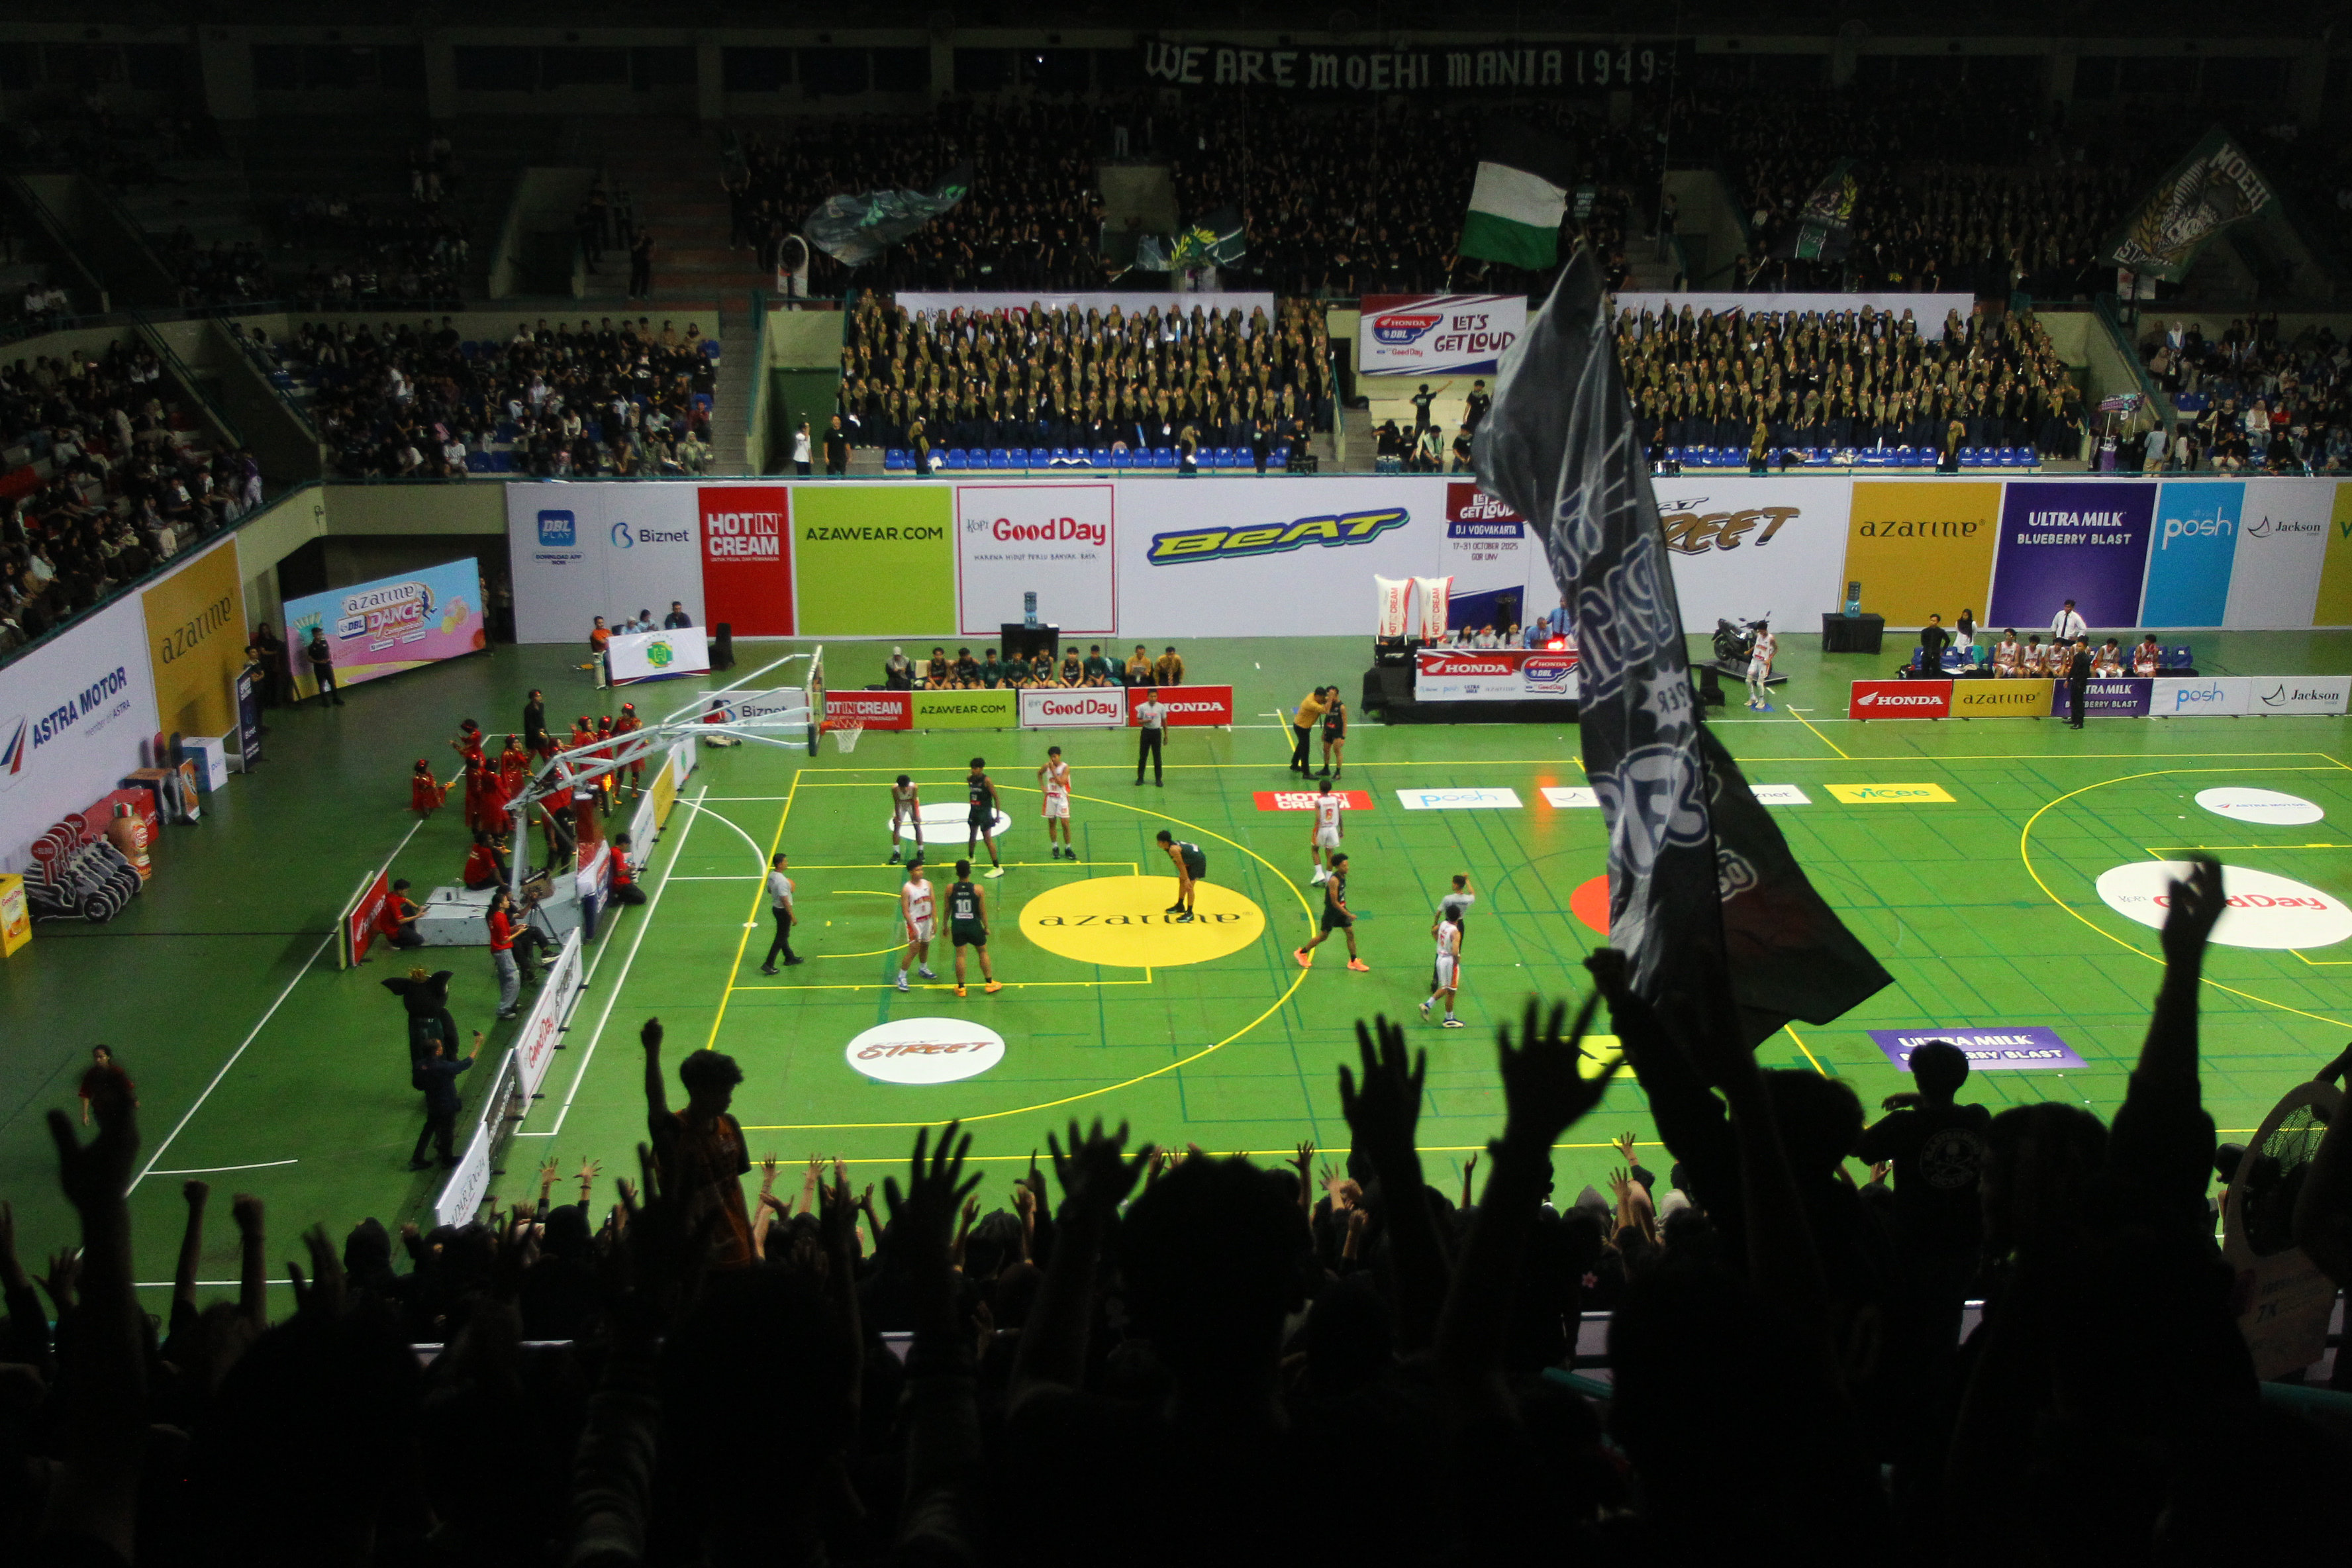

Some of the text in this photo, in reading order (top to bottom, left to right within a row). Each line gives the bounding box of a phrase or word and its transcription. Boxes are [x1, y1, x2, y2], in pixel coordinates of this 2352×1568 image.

[1144, 40, 1655, 91] WE ARE MOEHI MANIA 1949
[1452, 314, 1489, 331] LET'S
[1390, 330, 1408, 339] DBL
[1434, 332, 1516, 354] GET LOUD
[1460, 506, 1483, 518] GET
[2028, 511, 2124, 526] ULTRA MILK
[543, 520, 571, 532] DBL
[708, 513, 779, 535] HOT IN
[993, 517, 1055, 541] Good
[1059, 516, 1106, 546] Day
[1468, 524, 1516, 535] YOGYAKARTA
[1860, 520, 1979, 538] azarine
[2161, 507, 2233, 550] posh
[2275, 520, 2321, 532] Jackson
[640, 529, 689, 542] Biznet
[806, 526, 943, 540] AZAWEAR.COM
[1661, 507, 1801, 556] REET
[710, 536, 779, 556] CREAM
[2017, 533, 2132, 545] BLUEBERRY BLAST
[370, 601, 422, 634] DANCE
[348, 620, 364, 631] DBL
[1445, 663, 1508, 673] HONDA
[2083, 684, 2133, 695] TRA MILK
[2176, 681, 2224, 711] posh
[2290, 689, 2339, 701] Jackson
[1877, 695, 1943, 707] HONDA
[1963, 693, 2036, 705] azarine
[34, 666, 127, 750] ASTRA MOTOR
[113, 699, 131, 718] ASTRA
[826, 701, 842, 714] OT
[857, 701, 903, 714] CREAM
[920, 705, 1006, 715] AZAWEAR.COM
[1043, 699, 1084, 716] Good
[1086, 699, 1118, 718] Day
[1274, 793, 1322, 802] HOT
[1420, 790, 1498, 807] posh
[955, 899, 972, 914] 10
[2244, 894, 2328, 911] Day
[1973, 1035, 2035, 1046] MILK
[857, 1042, 995, 1060] STREET
[2001, 1049, 2063, 1059] BLAST
